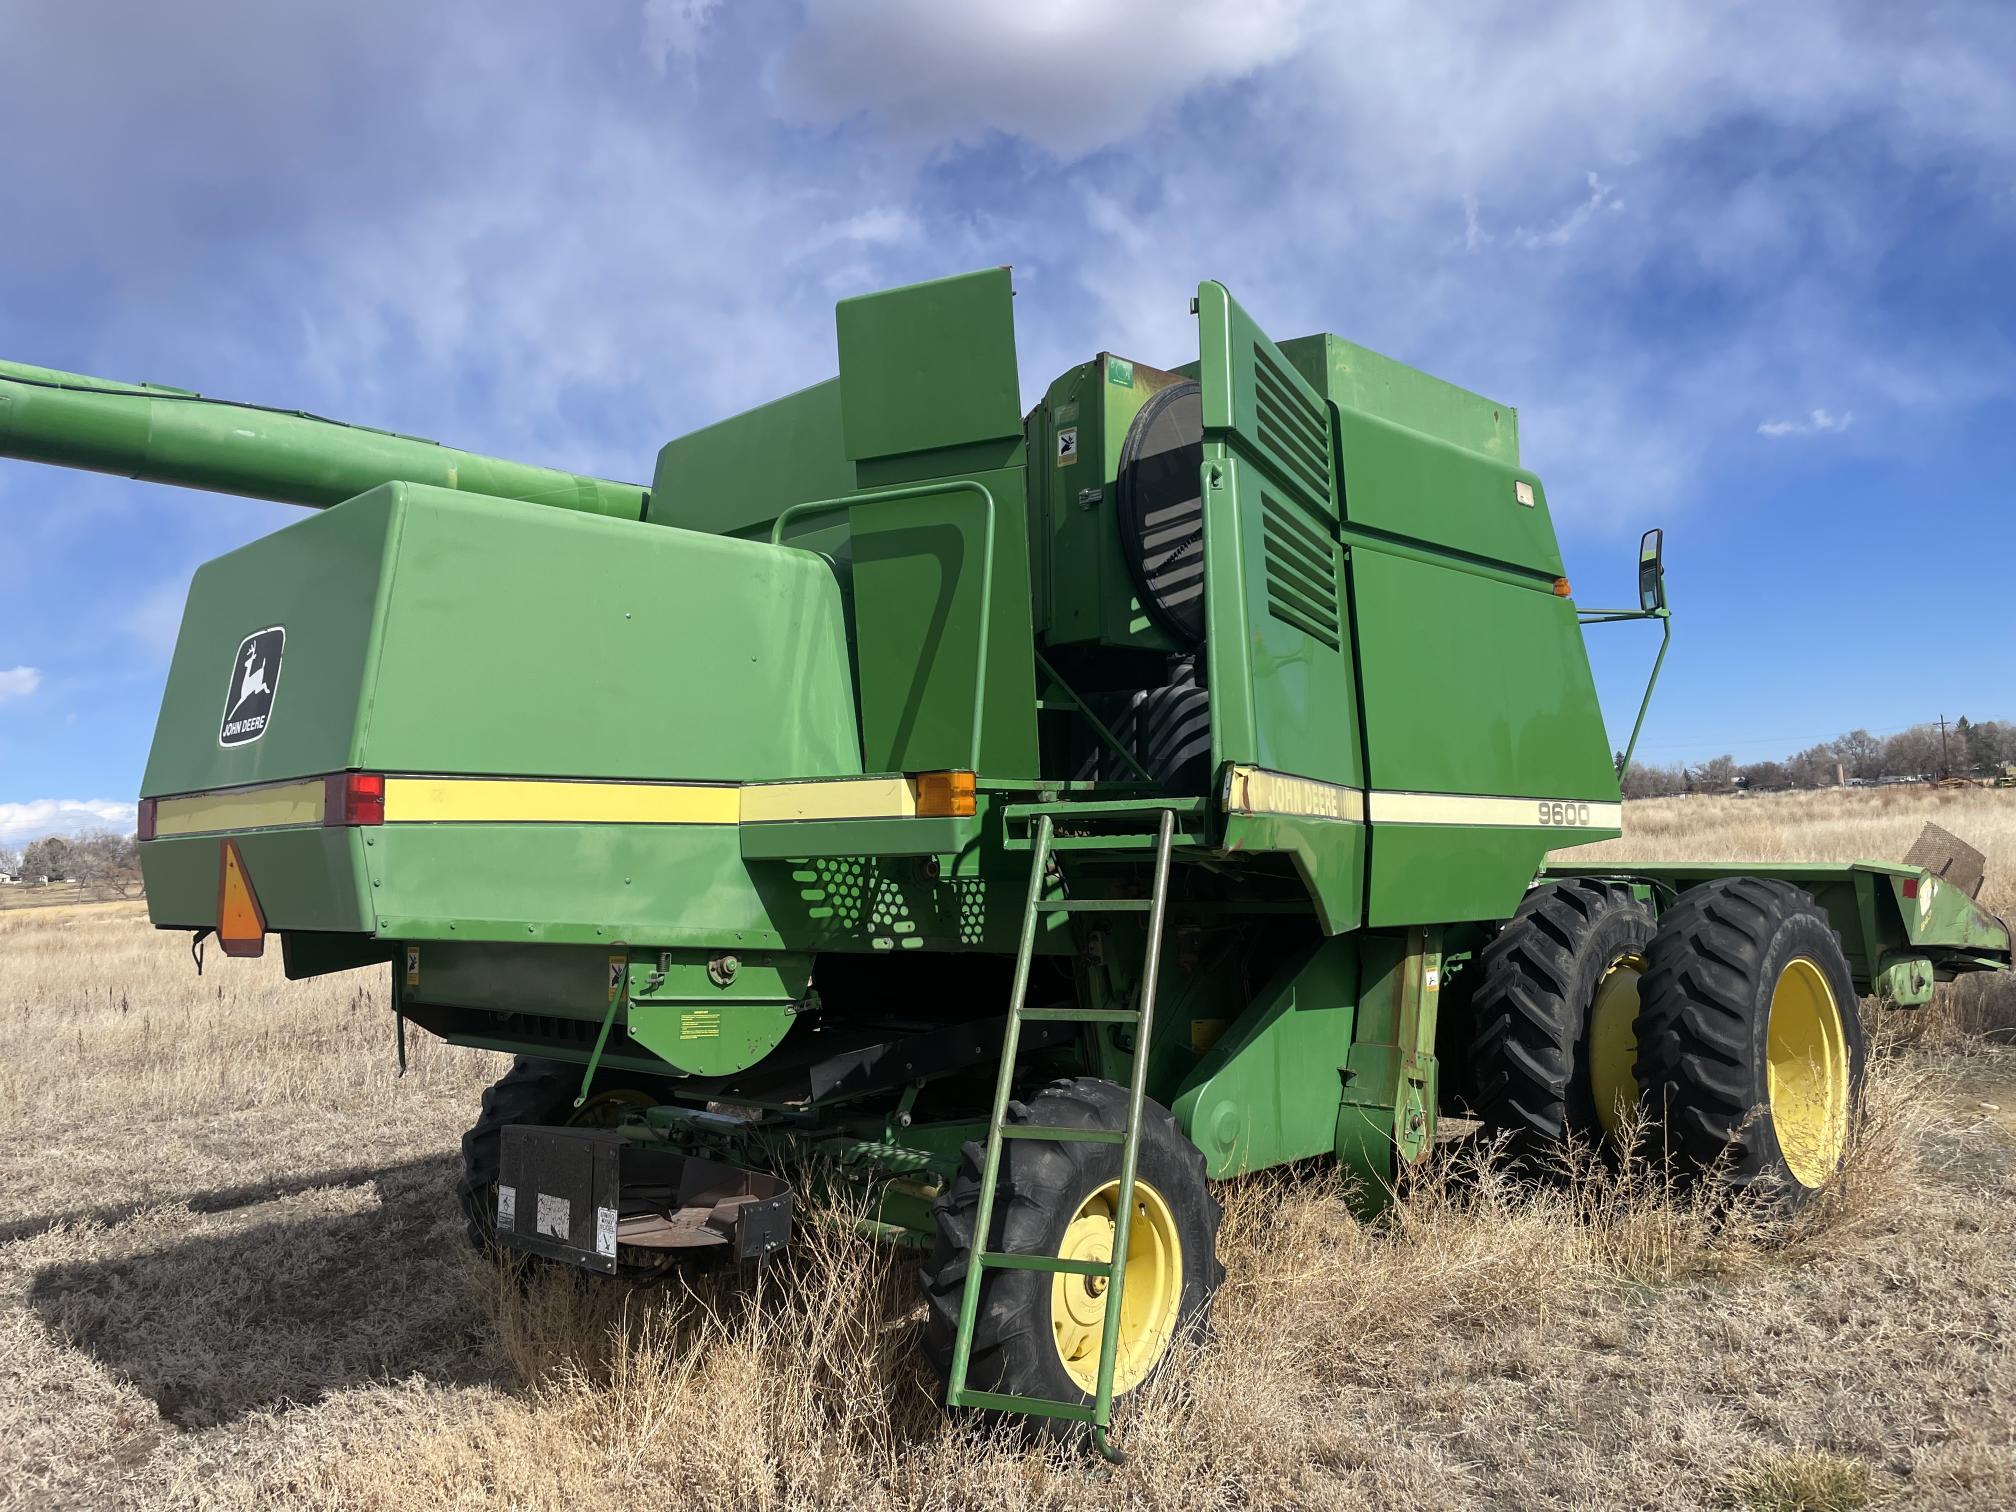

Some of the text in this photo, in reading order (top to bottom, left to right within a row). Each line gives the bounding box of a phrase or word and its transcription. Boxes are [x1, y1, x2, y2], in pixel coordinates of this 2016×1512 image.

[223, 715, 266, 737] JOHN DEERE
[1269, 777, 1338, 817] JOHN DEERE
[1538, 802, 1590, 825] 9600
